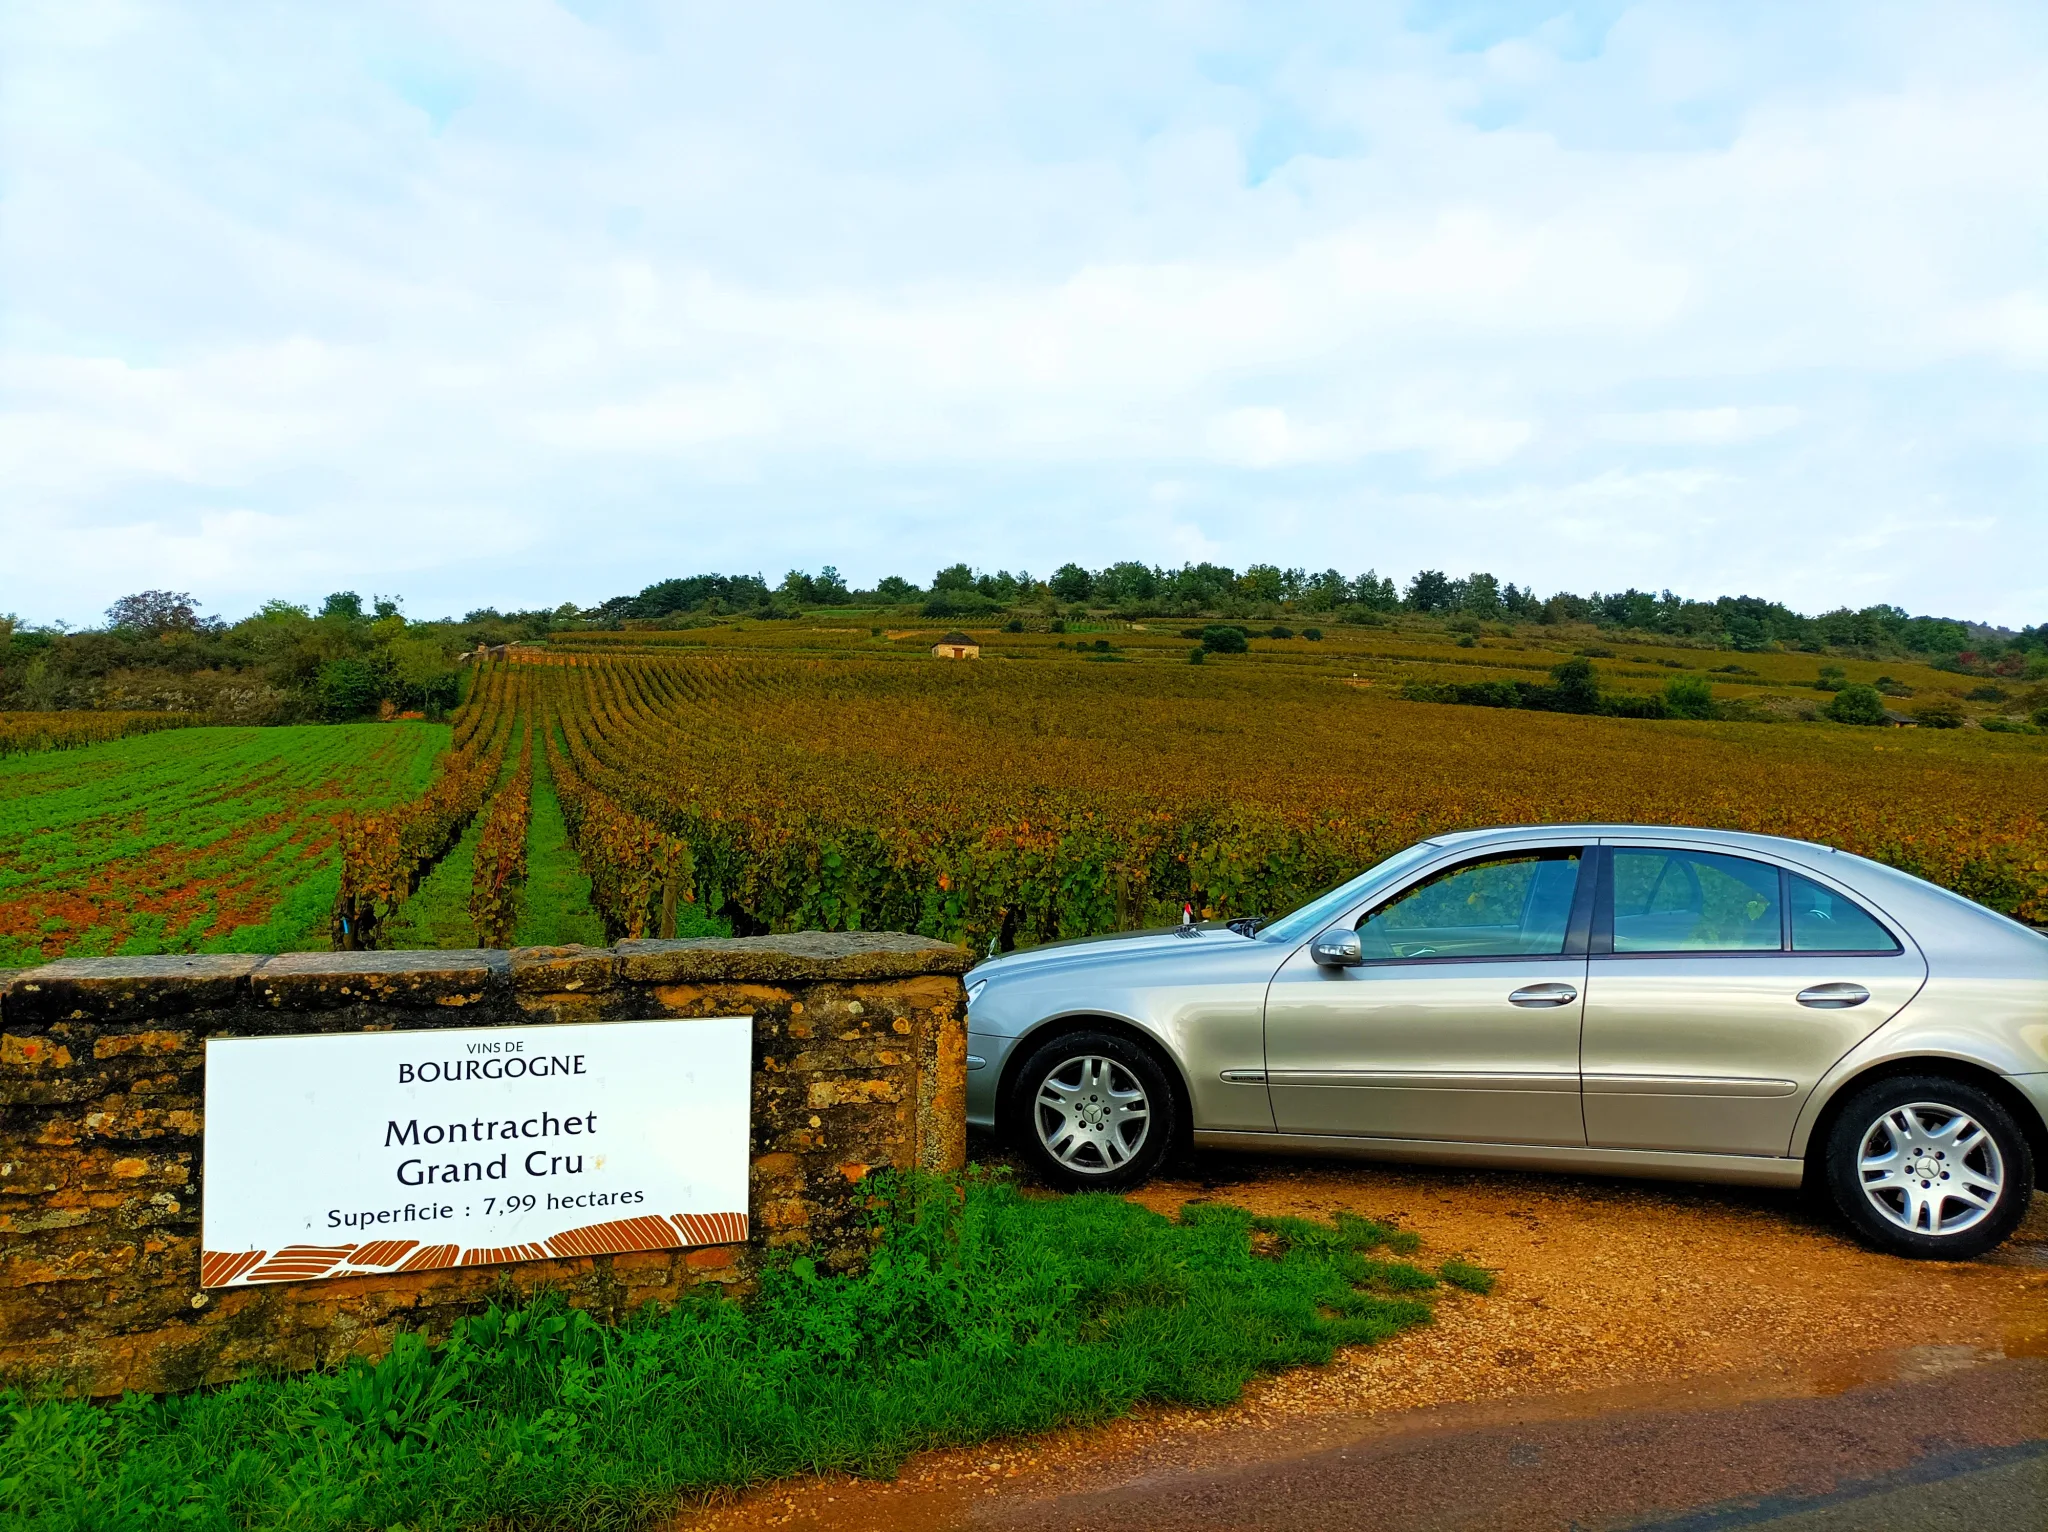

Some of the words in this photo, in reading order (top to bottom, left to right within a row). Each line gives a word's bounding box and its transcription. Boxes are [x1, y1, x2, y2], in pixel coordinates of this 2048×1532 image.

[466, 1042, 501, 1054] VINS
[505, 1041, 524, 1053] DE
[398, 1054, 588, 1084] BOURGOGNE
[384, 1110, 599, 1147] Montrachet
[396, 1153, 508, 1186] Grand
[524, 1150, 584, 1177] Cru
[327, 1202, 455, 1231] Superficie
[483, 1193, 537, 1217] 7,99
[547, 1189, 645, 1211] hectares
